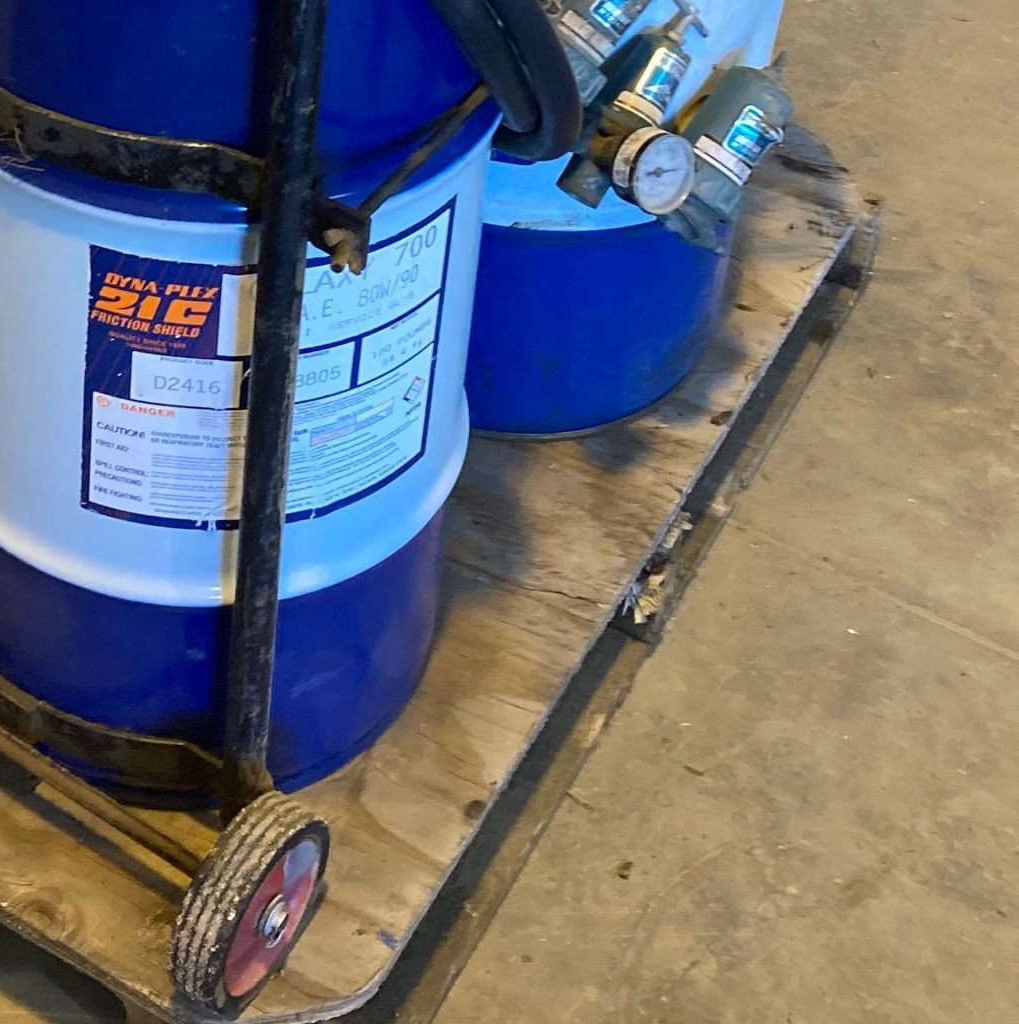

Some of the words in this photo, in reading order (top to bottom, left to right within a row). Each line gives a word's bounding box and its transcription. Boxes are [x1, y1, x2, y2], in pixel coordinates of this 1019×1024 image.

[395, 224, 438, 268] 700
[357, 264, 420, 308] 80W/90
[91, 310, 150, 332] FRICTION
[153, 323, 201, 338] SHIELD
[153, 376, 222, 395] D2416
[121, 403, 175, 417] DANGER
[96, 421, 145, 439] CAUTION!
